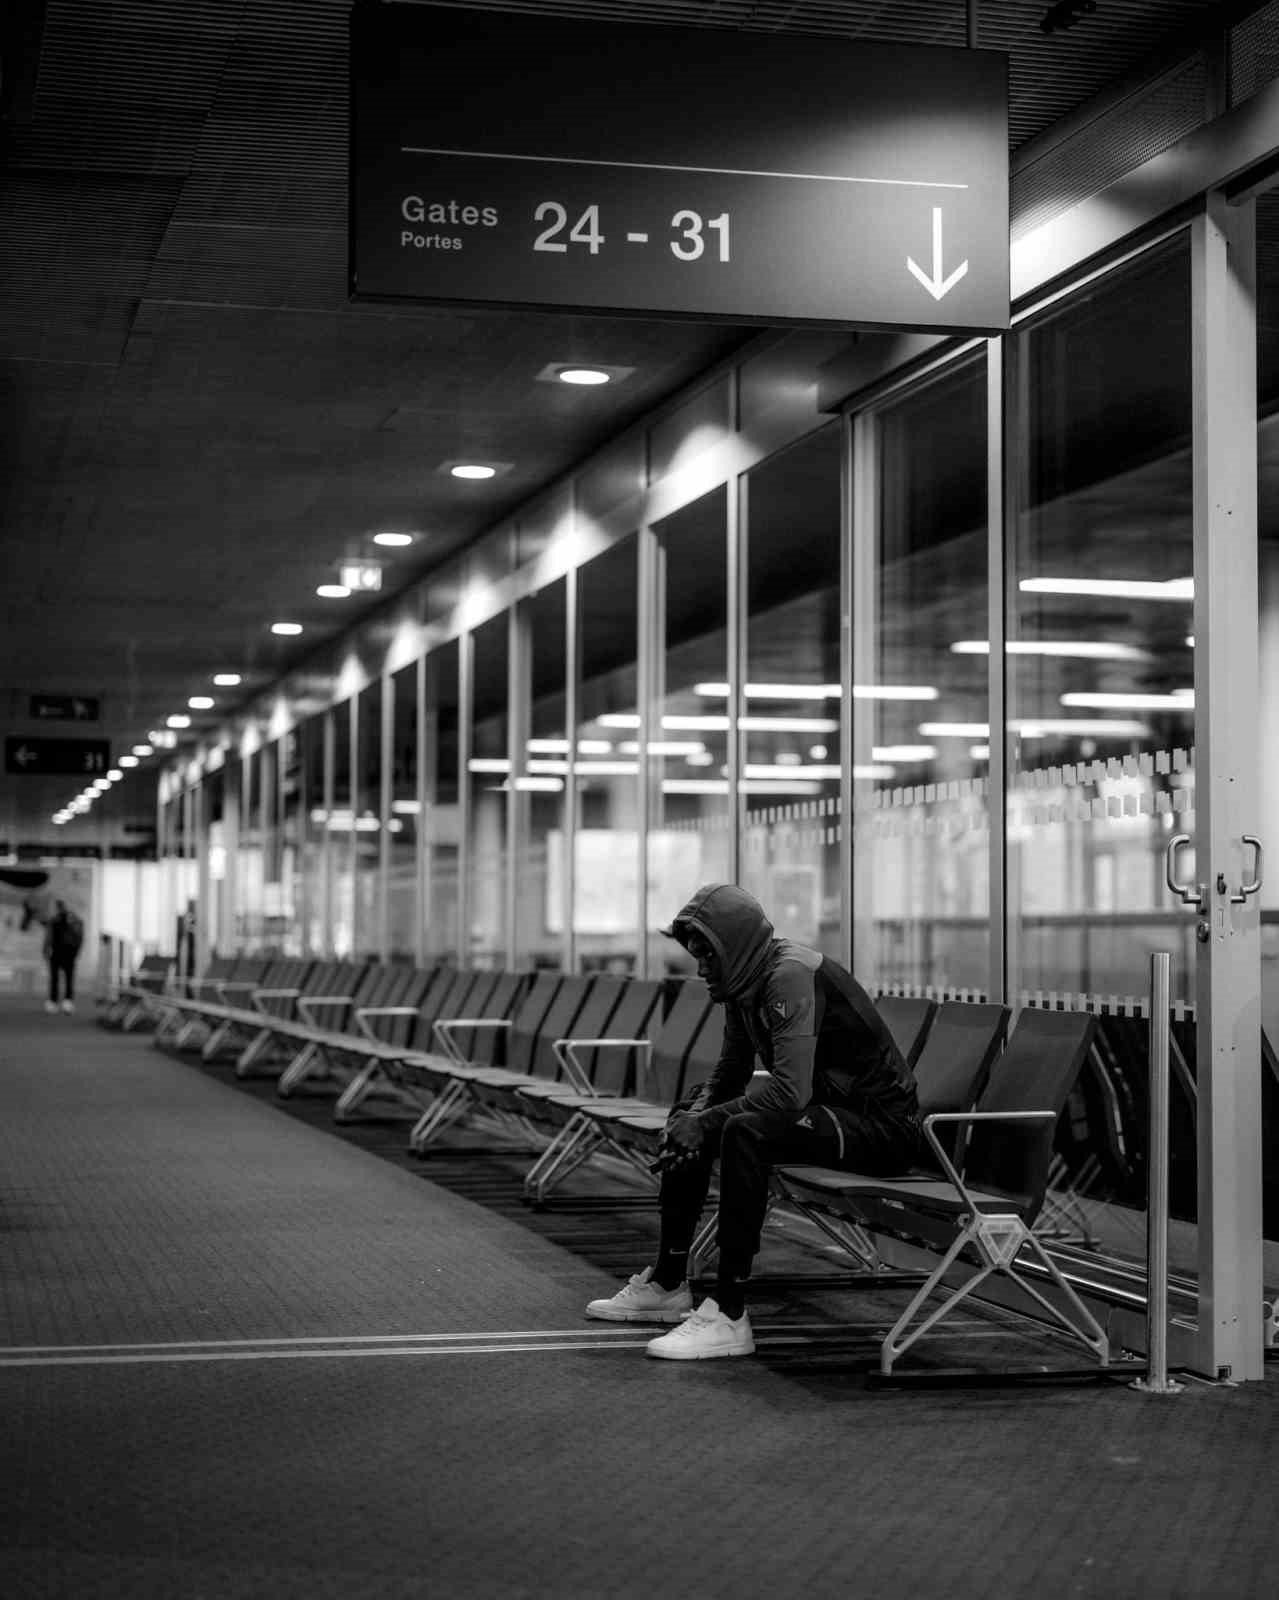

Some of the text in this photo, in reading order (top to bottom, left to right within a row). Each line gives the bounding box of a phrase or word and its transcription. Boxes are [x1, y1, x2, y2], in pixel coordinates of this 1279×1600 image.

[400, 231, 463, 251] Portes
[401, 196, 730, 263] Gates 24 - 31
